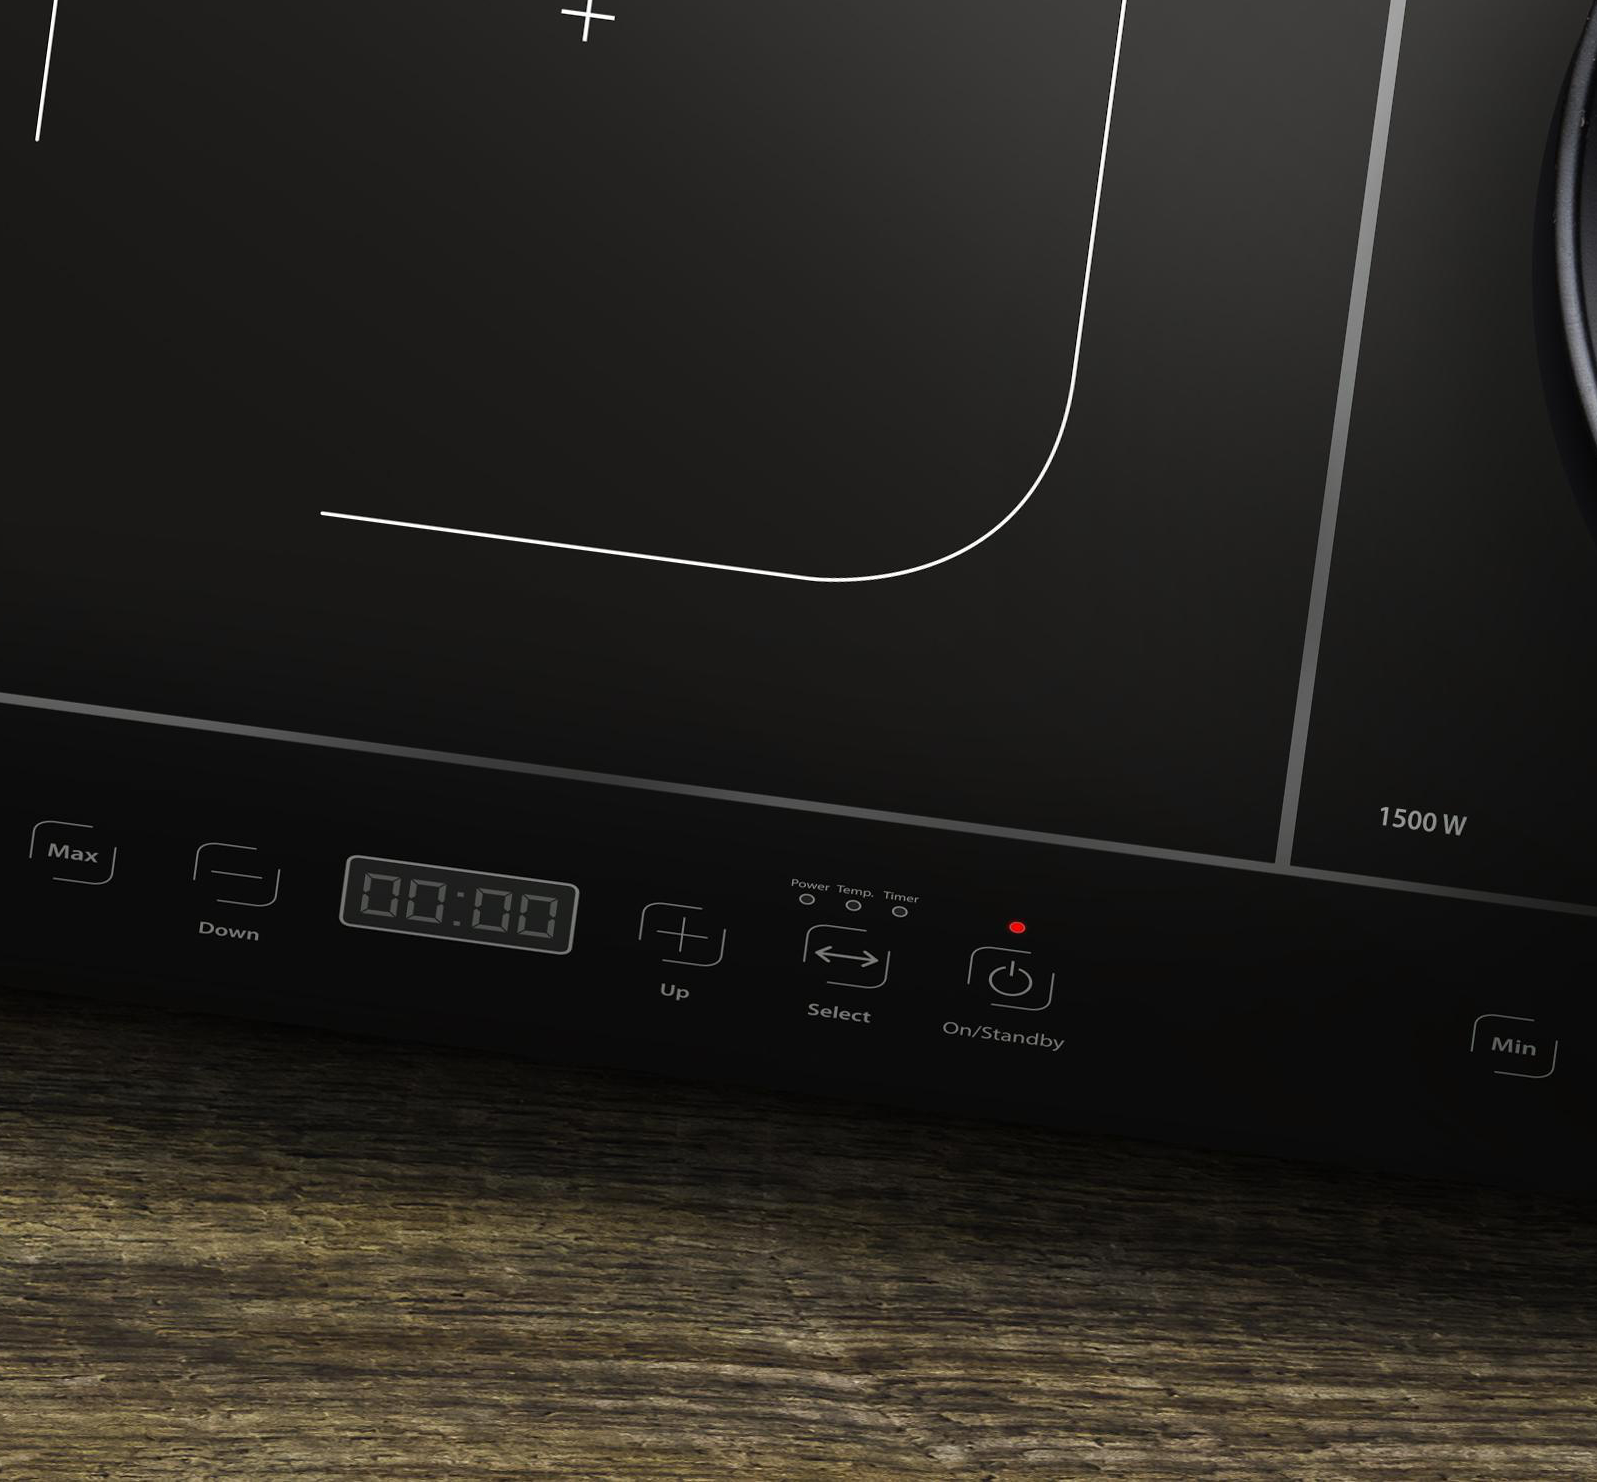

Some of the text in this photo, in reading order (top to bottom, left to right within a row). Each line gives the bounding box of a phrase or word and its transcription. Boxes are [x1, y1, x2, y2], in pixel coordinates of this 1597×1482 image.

[1379, 806, 1468, 836] 1500 W
[47, 842, 99, 864] Max
[790, 877, 920, 904] Power Temp. Timer
[198, 921, 260, 942] Down
[660, 982, 690, 1001] Up
[807, 1003, 872, 1024] Select
[942, 1021, 1065, 1052] On/Standby
[1491, 1036, 1537, 1057] Min
